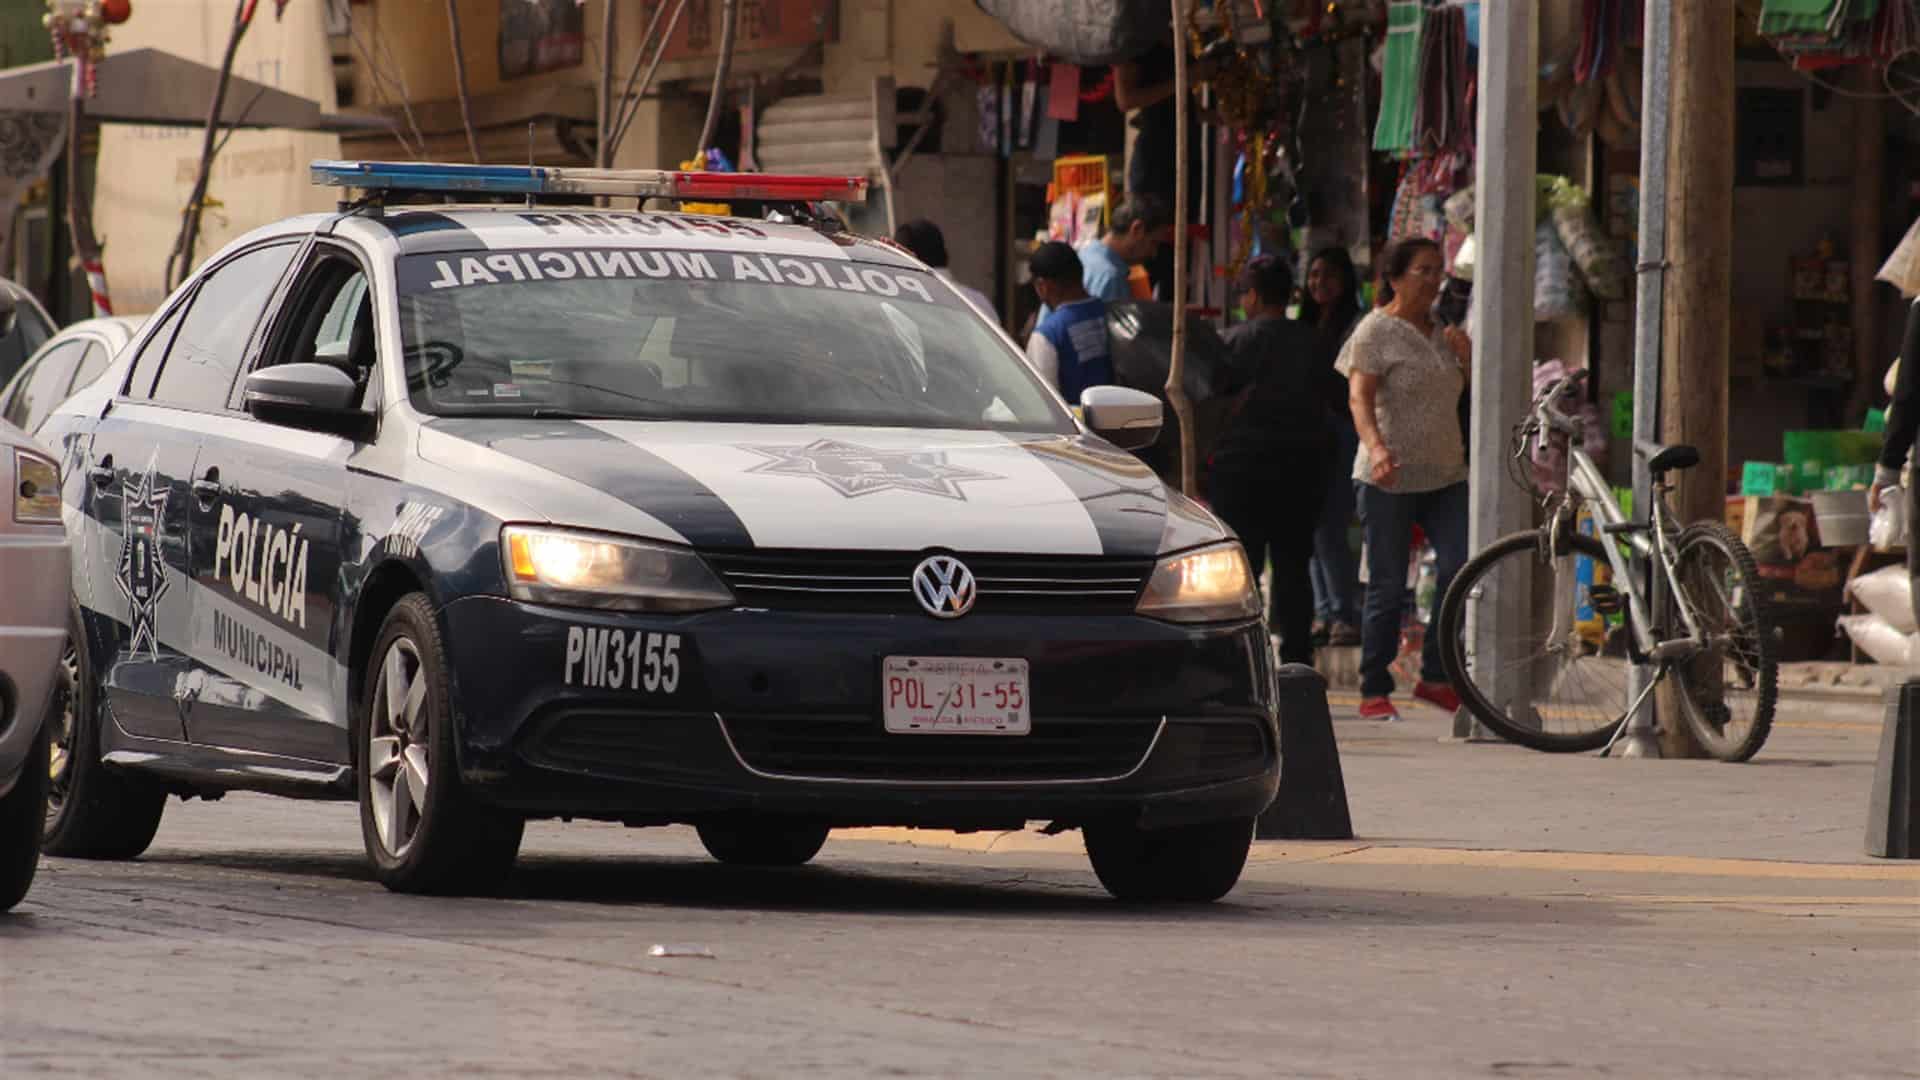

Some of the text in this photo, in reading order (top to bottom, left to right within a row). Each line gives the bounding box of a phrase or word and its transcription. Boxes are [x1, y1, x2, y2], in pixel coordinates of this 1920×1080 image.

[213, 503, 310, 630] POLICÍA
[213, 607, 304, 691] MUNICIPAL
[565, 626, 681, 693] PM3155
[889, 675, 1024, 709] POL-31-55
